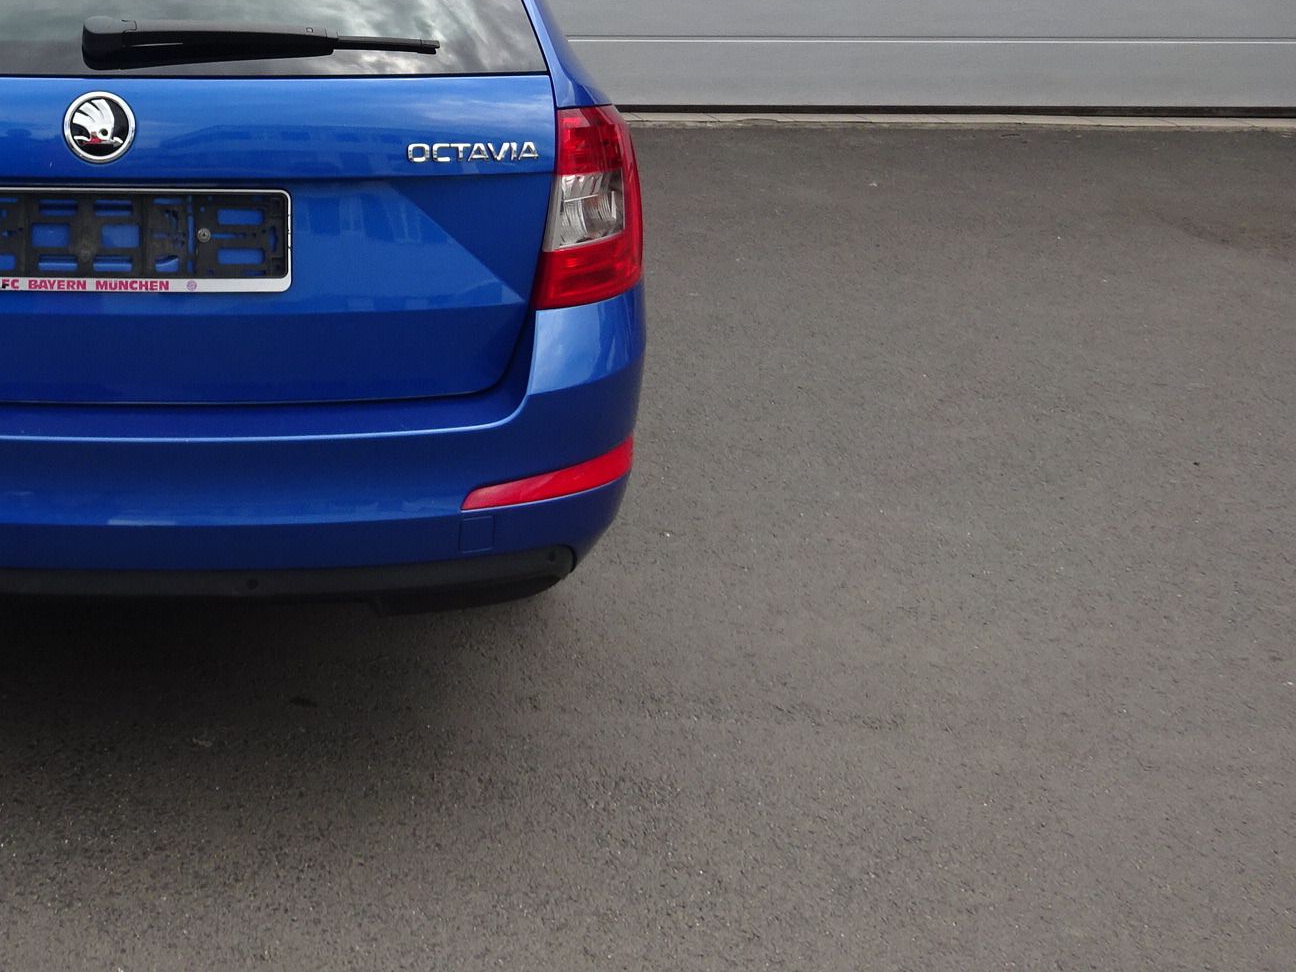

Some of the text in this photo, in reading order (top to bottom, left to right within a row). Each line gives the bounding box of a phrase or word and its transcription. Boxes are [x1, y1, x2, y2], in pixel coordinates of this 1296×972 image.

[407, 141, 539, 163] OCTAVIA
[1, 279, 20, 291] FC
[28, 279, 87, 291] BAYERN
